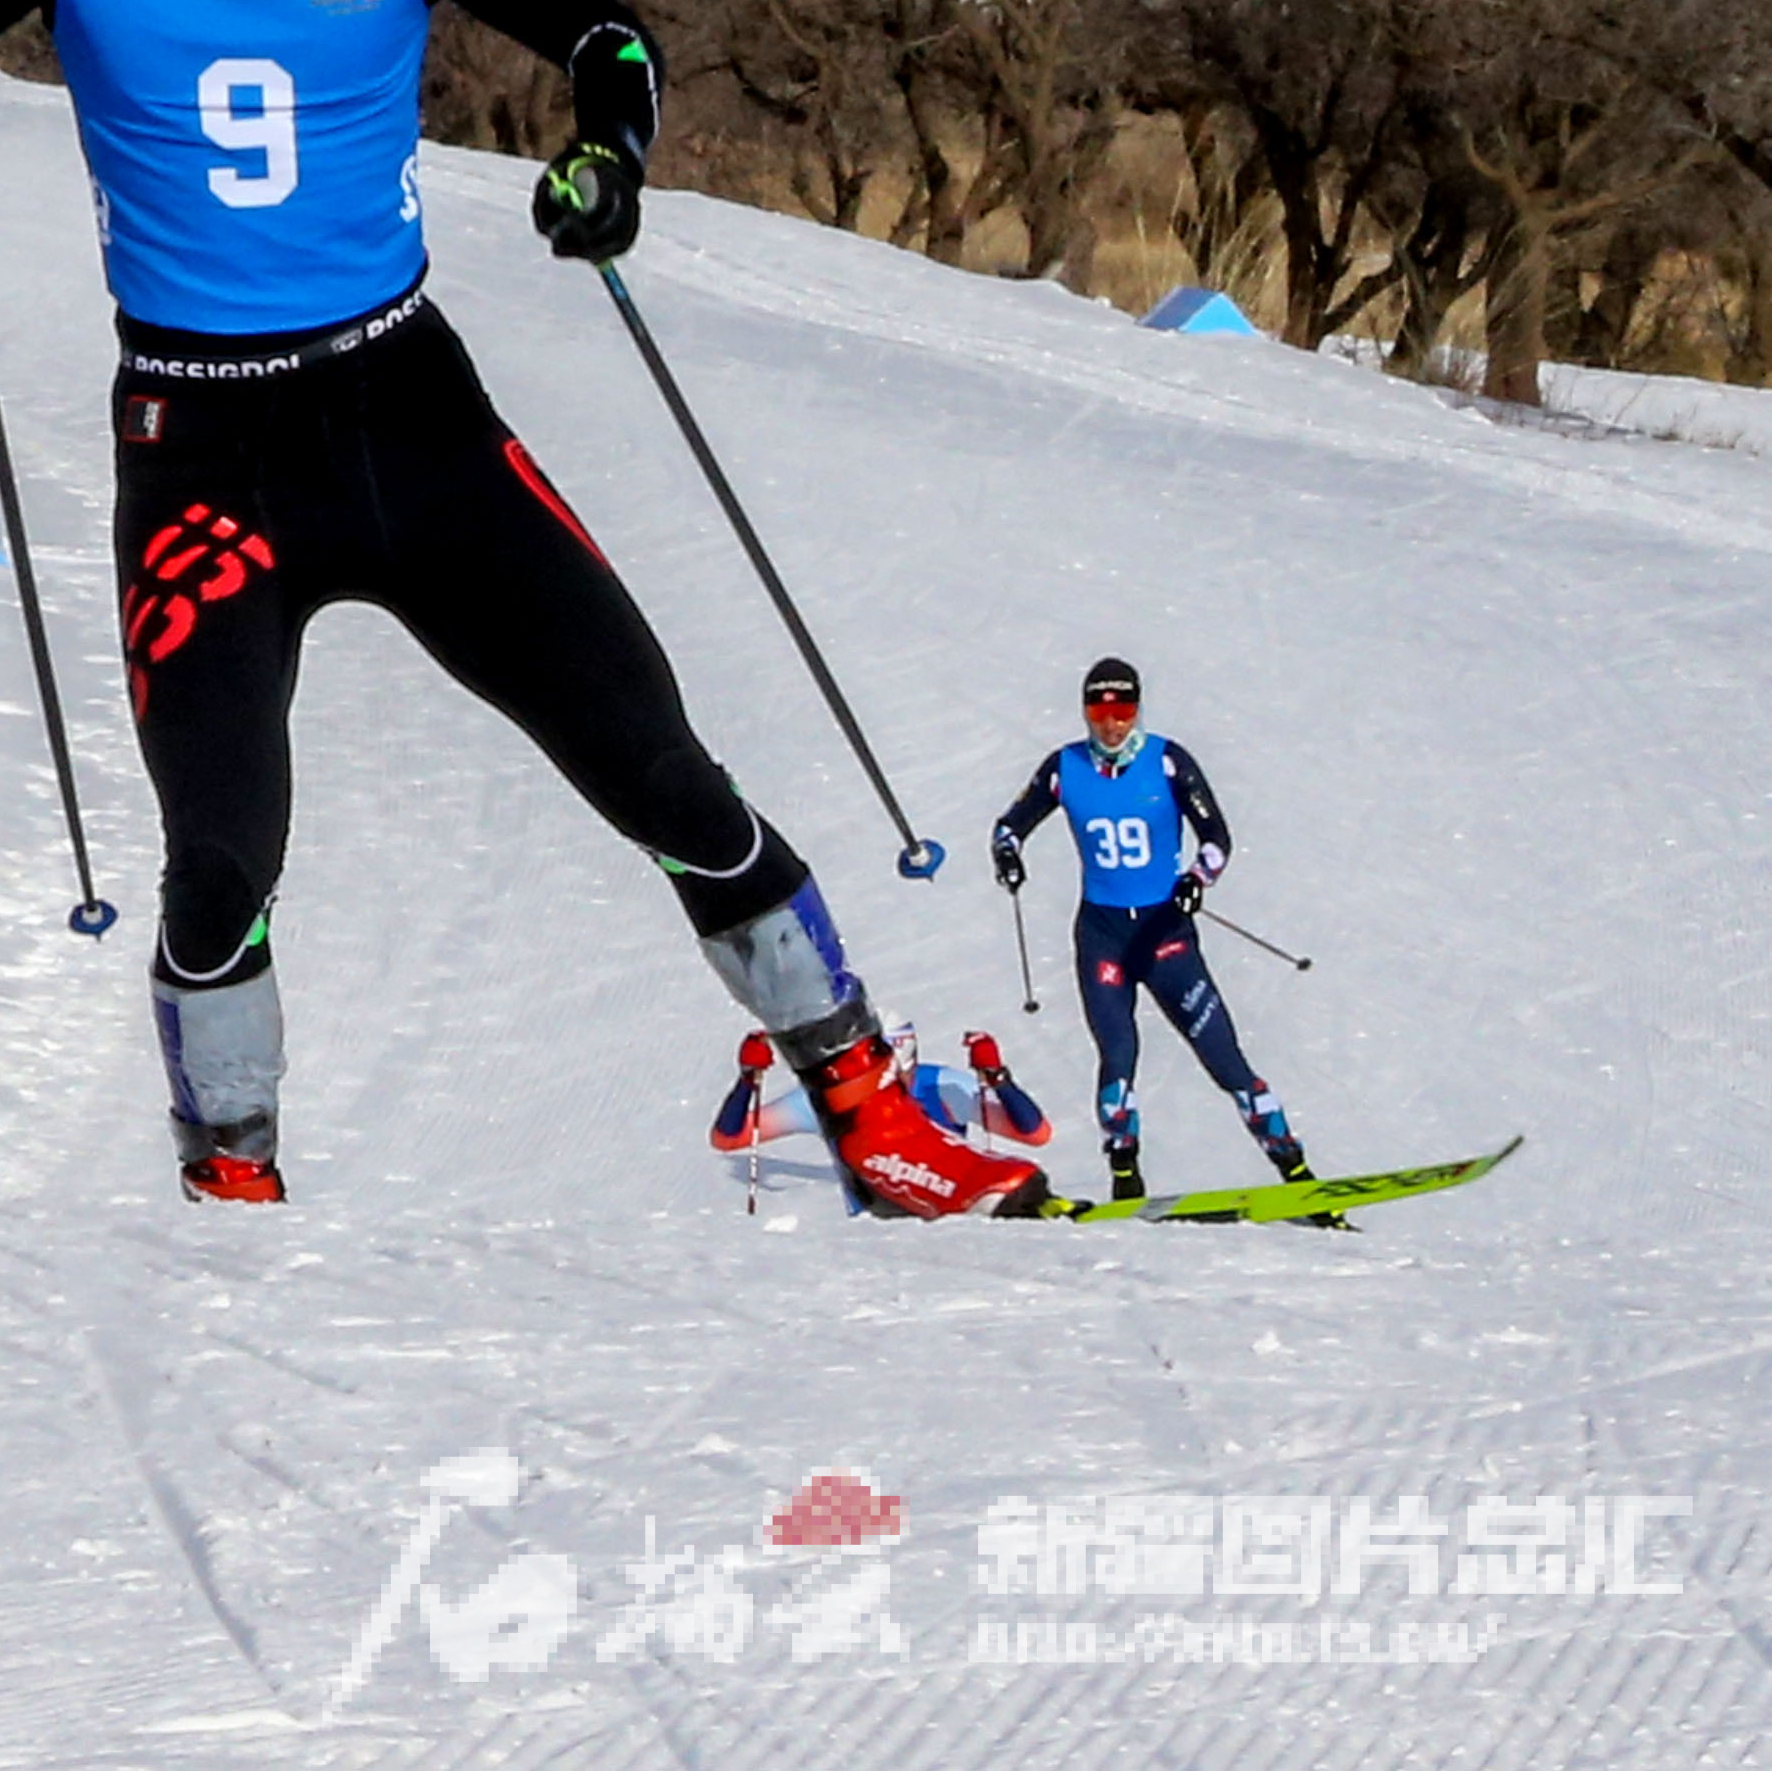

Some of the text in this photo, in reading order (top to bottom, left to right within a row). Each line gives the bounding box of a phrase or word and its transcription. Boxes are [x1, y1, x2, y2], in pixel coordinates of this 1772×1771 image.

[198, 58, 299, 208] 9
[1085, 817, 1151, 870] 39
[862, 1152, 957, 1198] alpina
